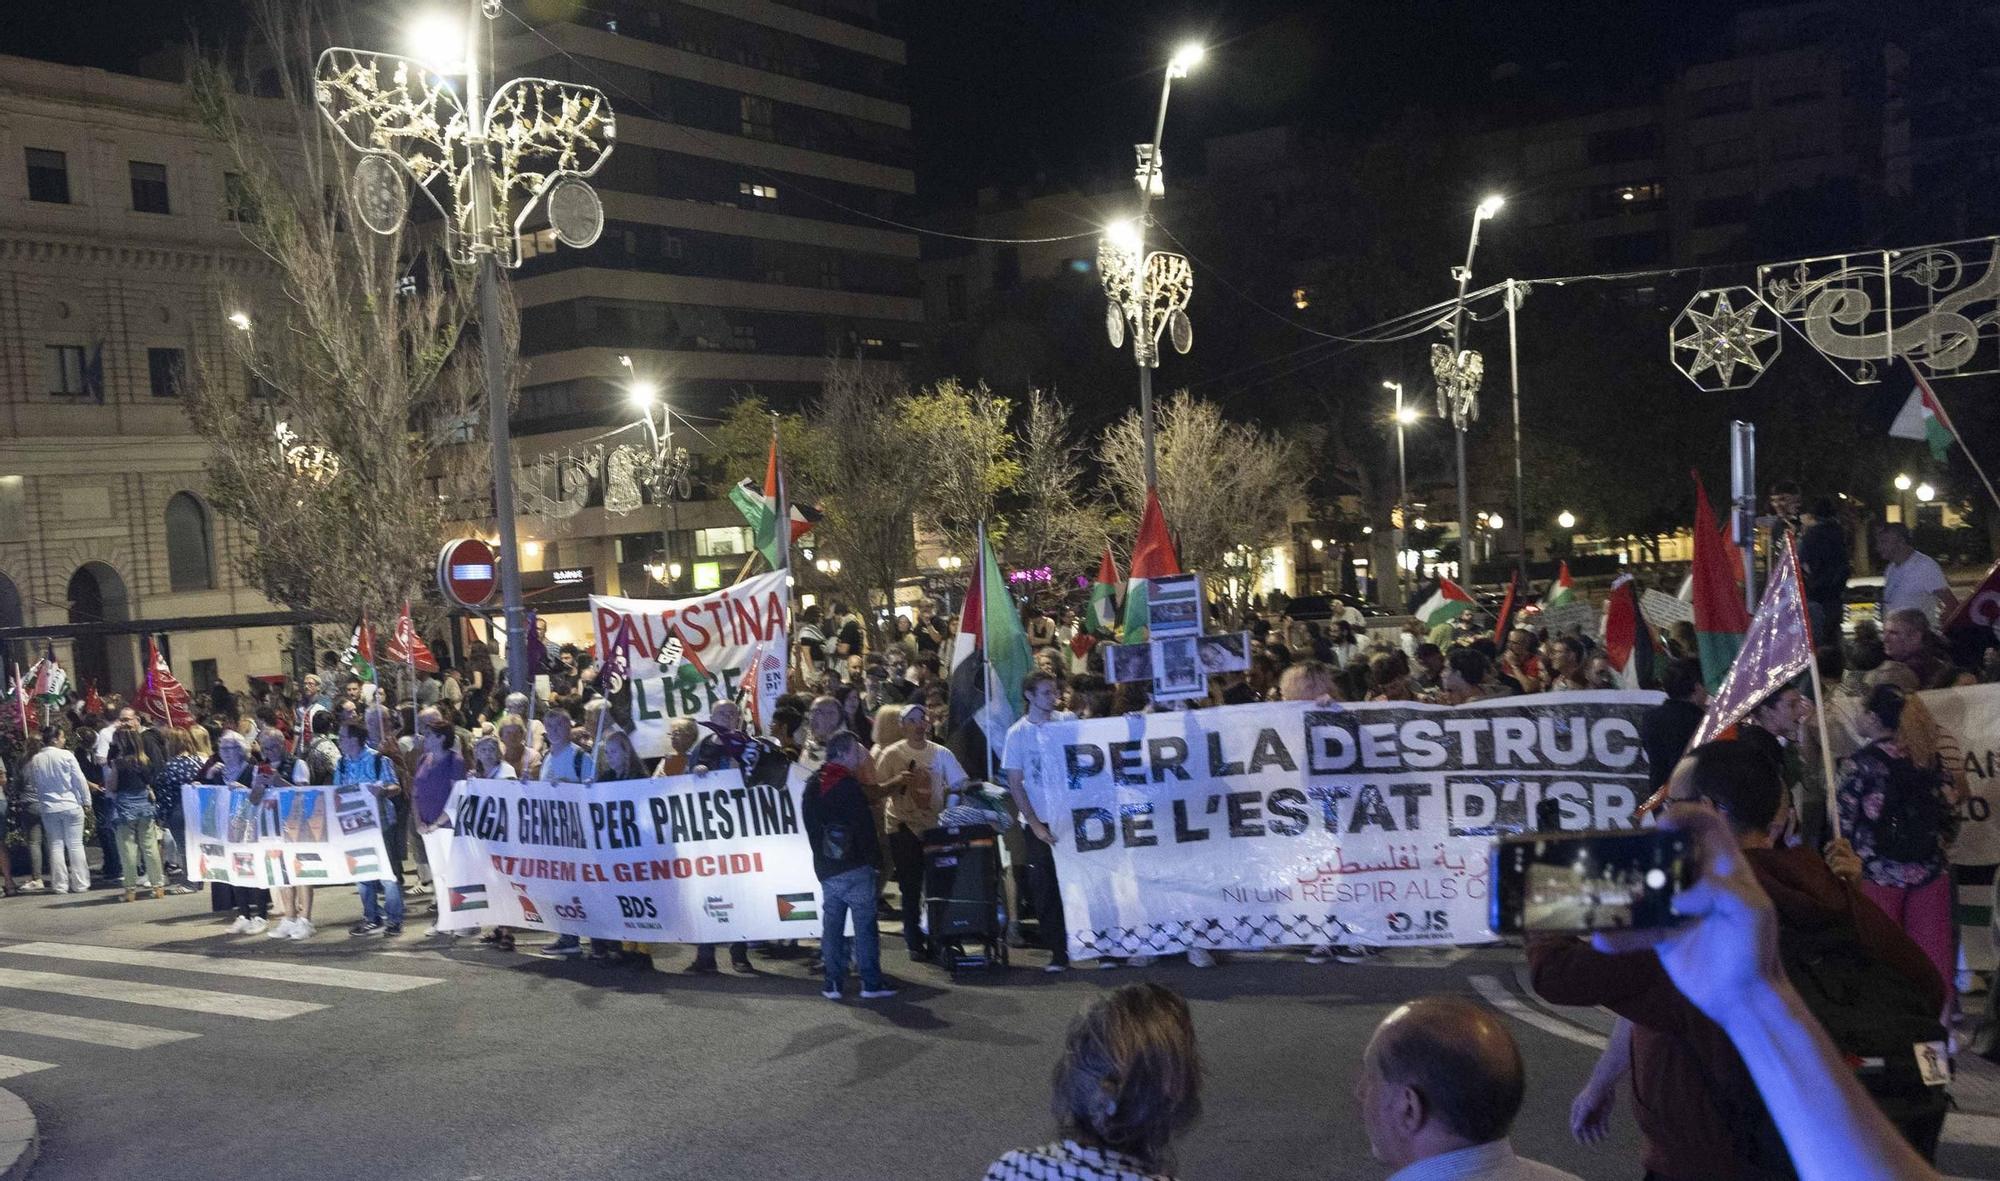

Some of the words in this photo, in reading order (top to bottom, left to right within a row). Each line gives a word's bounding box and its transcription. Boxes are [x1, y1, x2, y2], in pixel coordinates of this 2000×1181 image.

[1064, 736, 1194, 790] PER
[1208, 728, 1298, 778] LA
[1311, 716, 1649, 770] DESTRUC
[518, 797, 587, 849] GENERAL
[589, 799, 641, 850] PER
[649, 786, 798, 845] PALESTINA
[1072, 801, 1158, 853] DE
[1174, 783, 1432, 844] L'ESTAT
[582, 863, 609, 882] EL
[614, 852, 764, 883] GENOCIDI
[1431, 842, 1488, 878] رية
[615, 895, 658, 918] BDS
[1222, 887, 1247, 903] NI
[1254, 886, 1293, 903] UN
[1303, 881, 1396, 903] RESPIR
[1404, 879, 1457, 901] ALS
[1466, 878, 1488, 900] C
